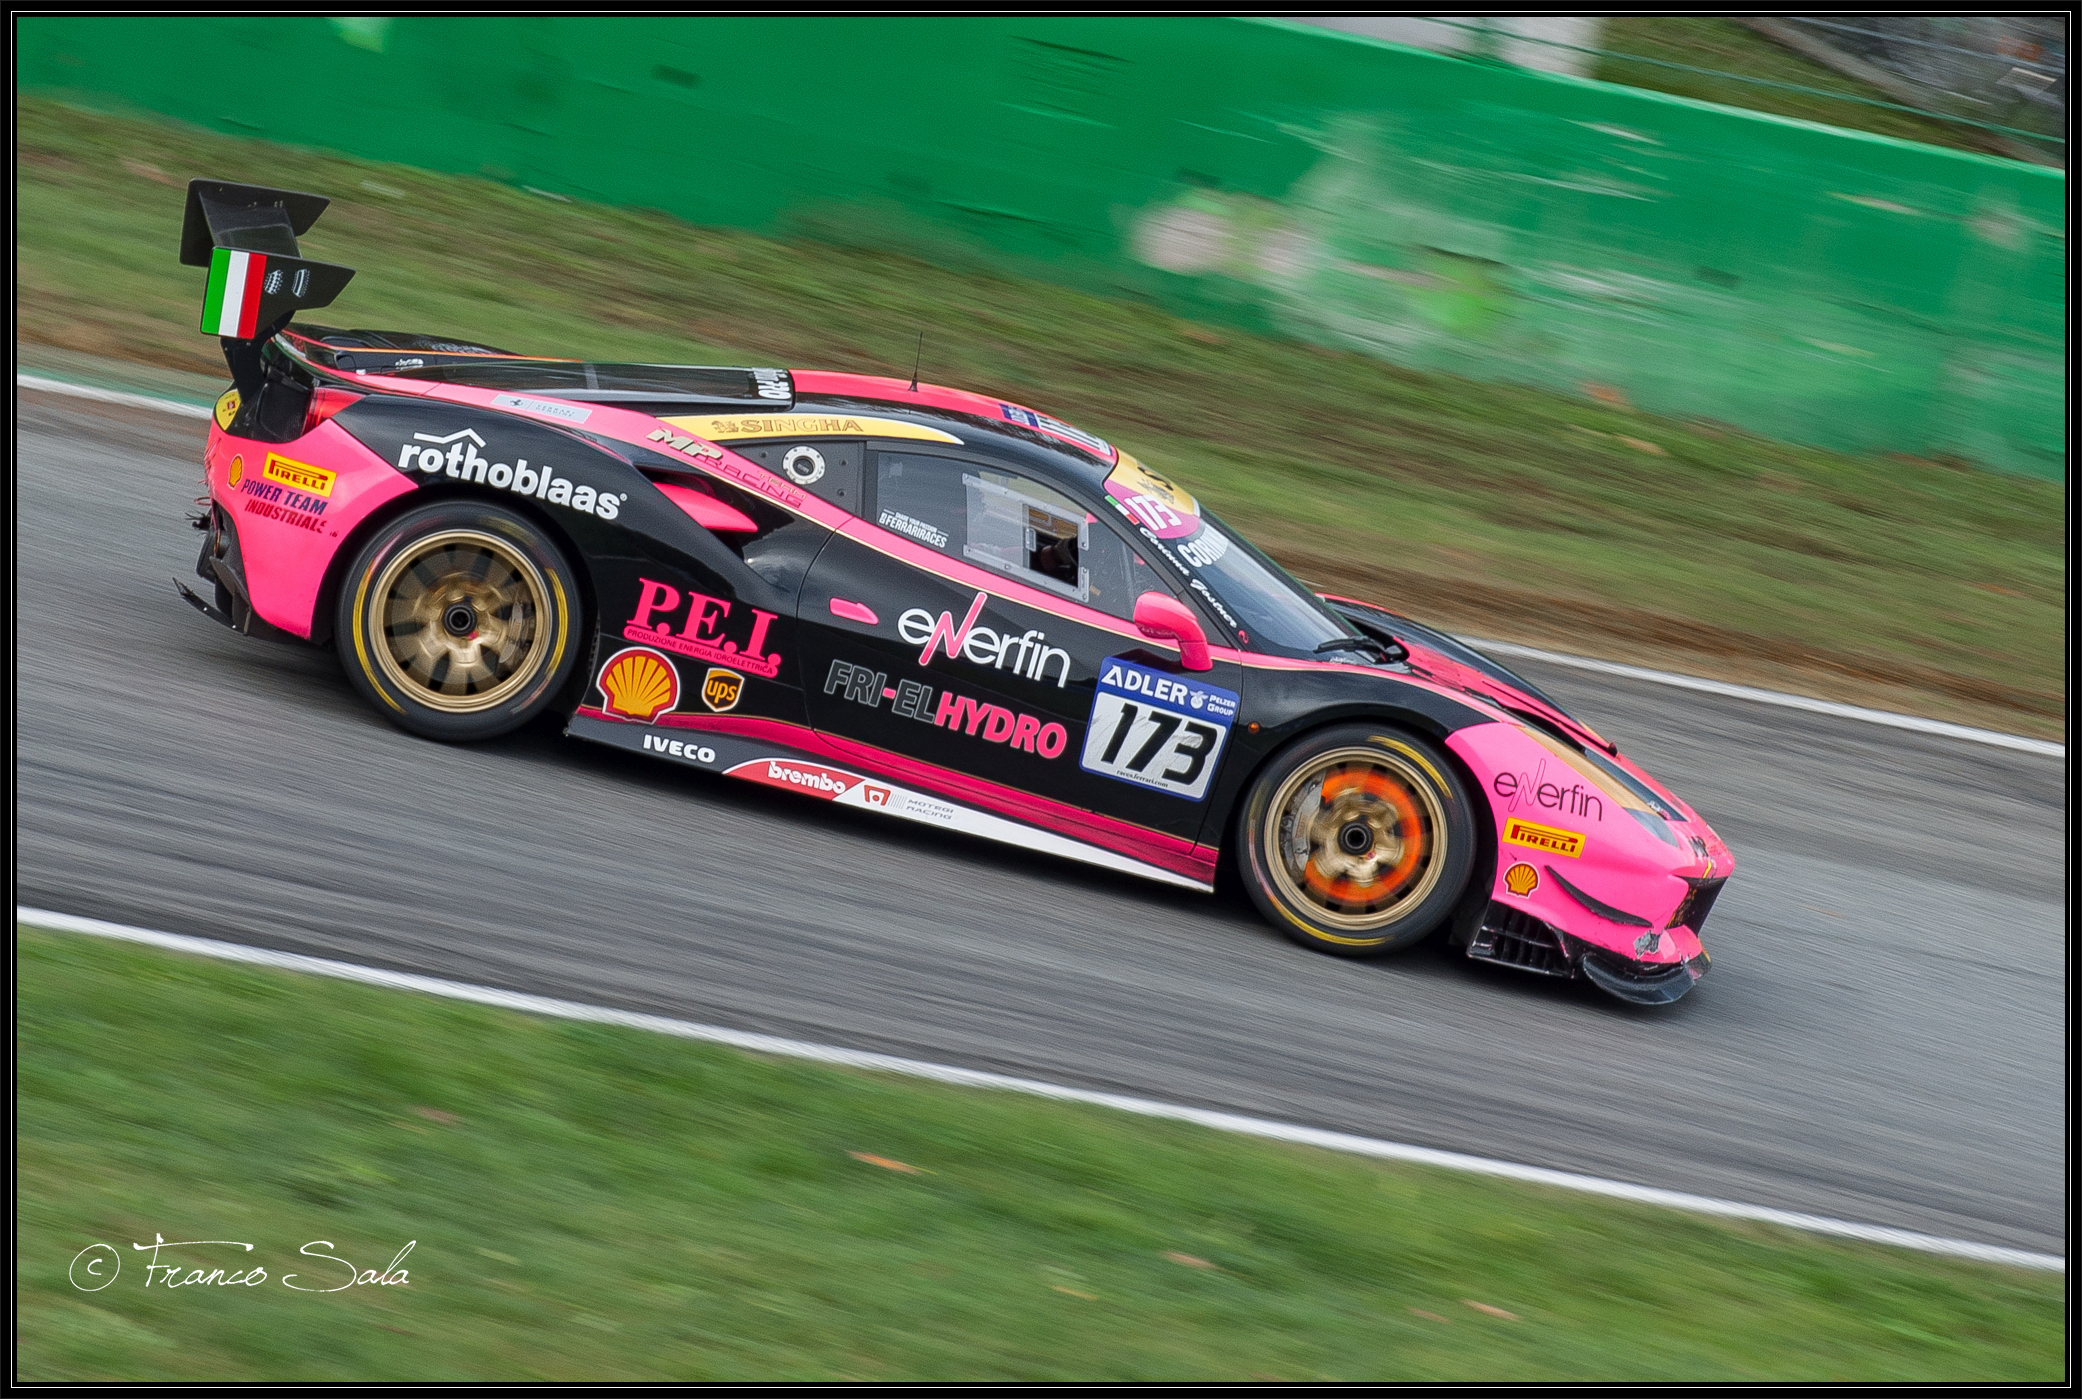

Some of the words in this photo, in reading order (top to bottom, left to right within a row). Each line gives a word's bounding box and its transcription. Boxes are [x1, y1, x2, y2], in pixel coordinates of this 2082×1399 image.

[741, 418, 863, 433] SINGHA
[646, 428, 723, 460] MP
[268, 458, 329, 491] PIRELLI
[397, 441, 621, 521] rothoblaas
[695, 454, 804, 509] RACING
[240, 478, 283, 503] POWER
[283, 490, 328, 516] TEAM
[1123, 493, 1183, 531] 173
[244, 498, 328, 534] INDUSTRIALS
[626, 577, 782, 667] P.E.I.
[626, 629, 677, 649] PRODUZIONE
[678, 642, 713, 658] ENERGIA
[713, 651, 774, 675] IDROELETTRICA
[706, 679, 738, 705] ups
[1100, 664, 1189, 706] ADLER
[1208, 694, 1237, 708] PELZER
[1206, 705, 1235, 717] GROUP
[642, 733, 716, 764] IVECO
[1100, 702, 1218, 786] 173
[767, 760, 847, 795] brembo
[905, 805, 953, 820] RACING
[907, 799, 955, 814] MOTEGI
[1510, 823, 1579, 853] PIRELLI
